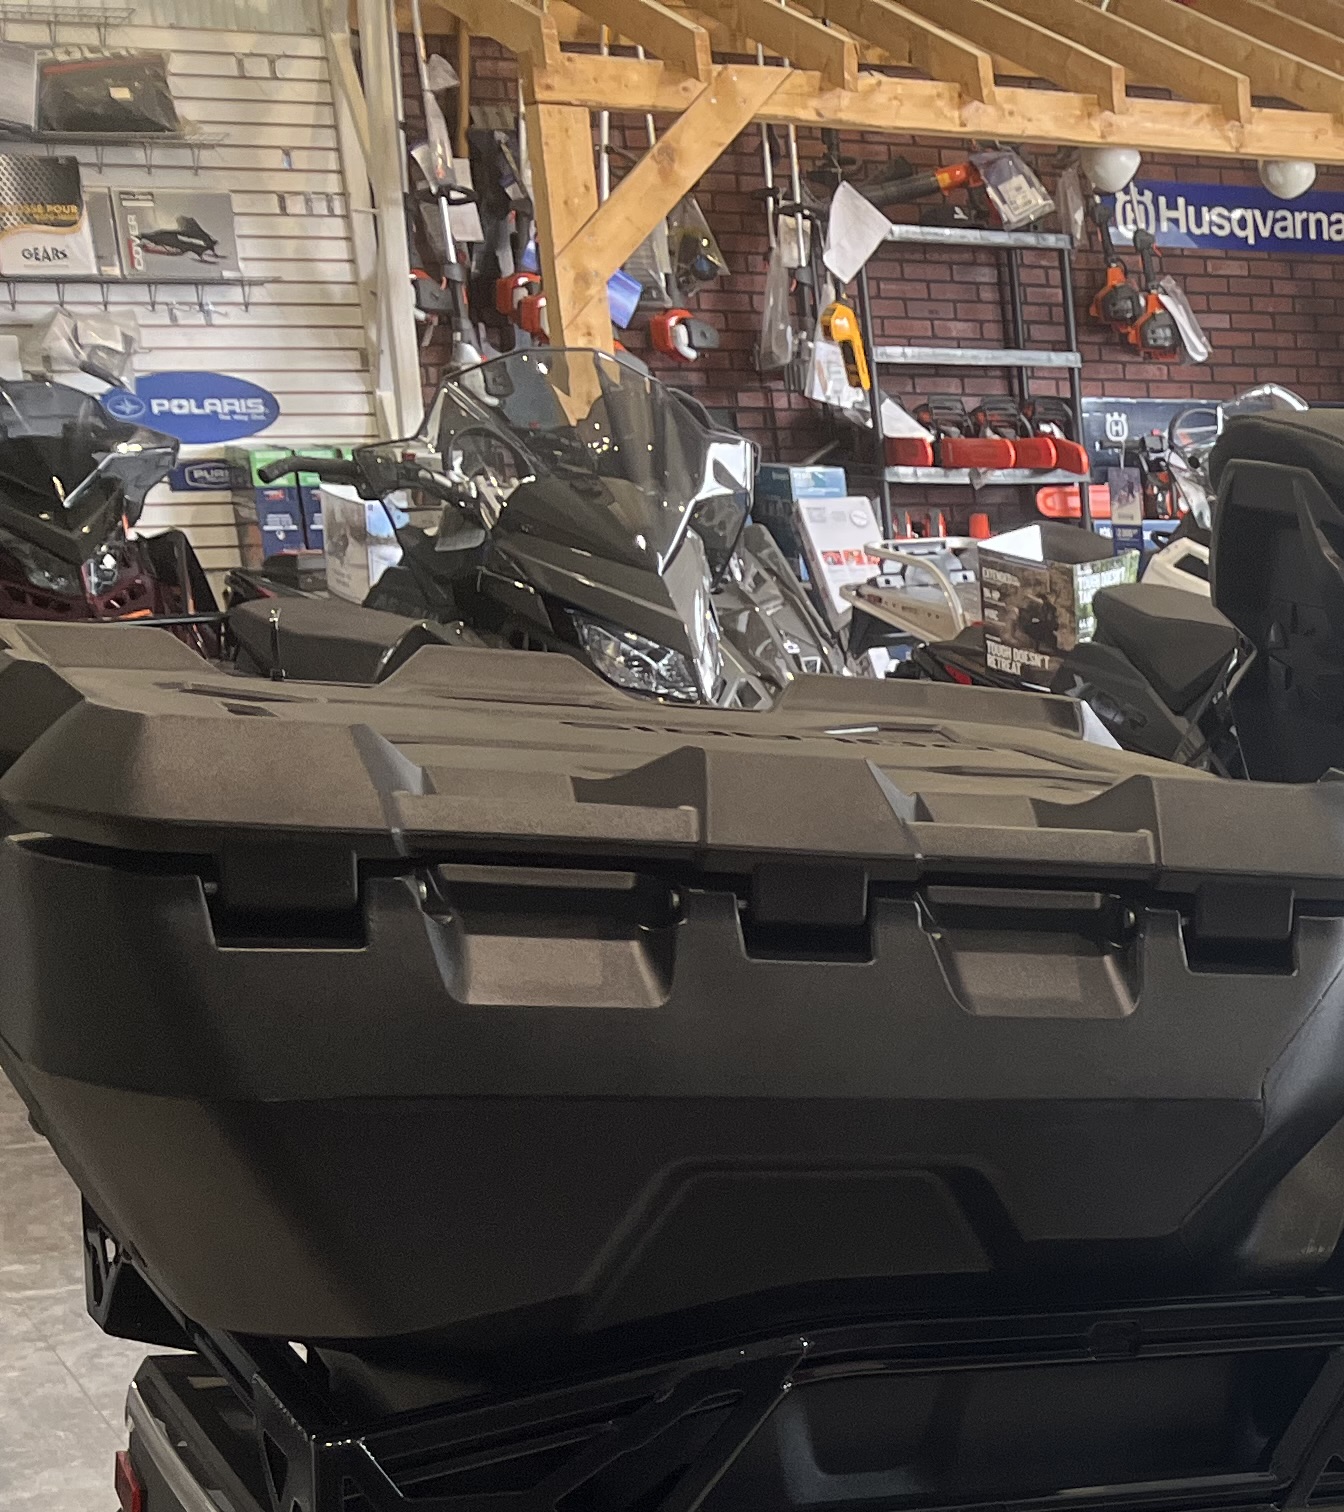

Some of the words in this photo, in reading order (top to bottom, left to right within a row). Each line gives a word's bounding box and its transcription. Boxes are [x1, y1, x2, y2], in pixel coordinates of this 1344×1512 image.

[127, 214, 145, 271] COVER
[21, 247, 68, 262] GEARS
[151, 399, 265, 416] POLARIS
